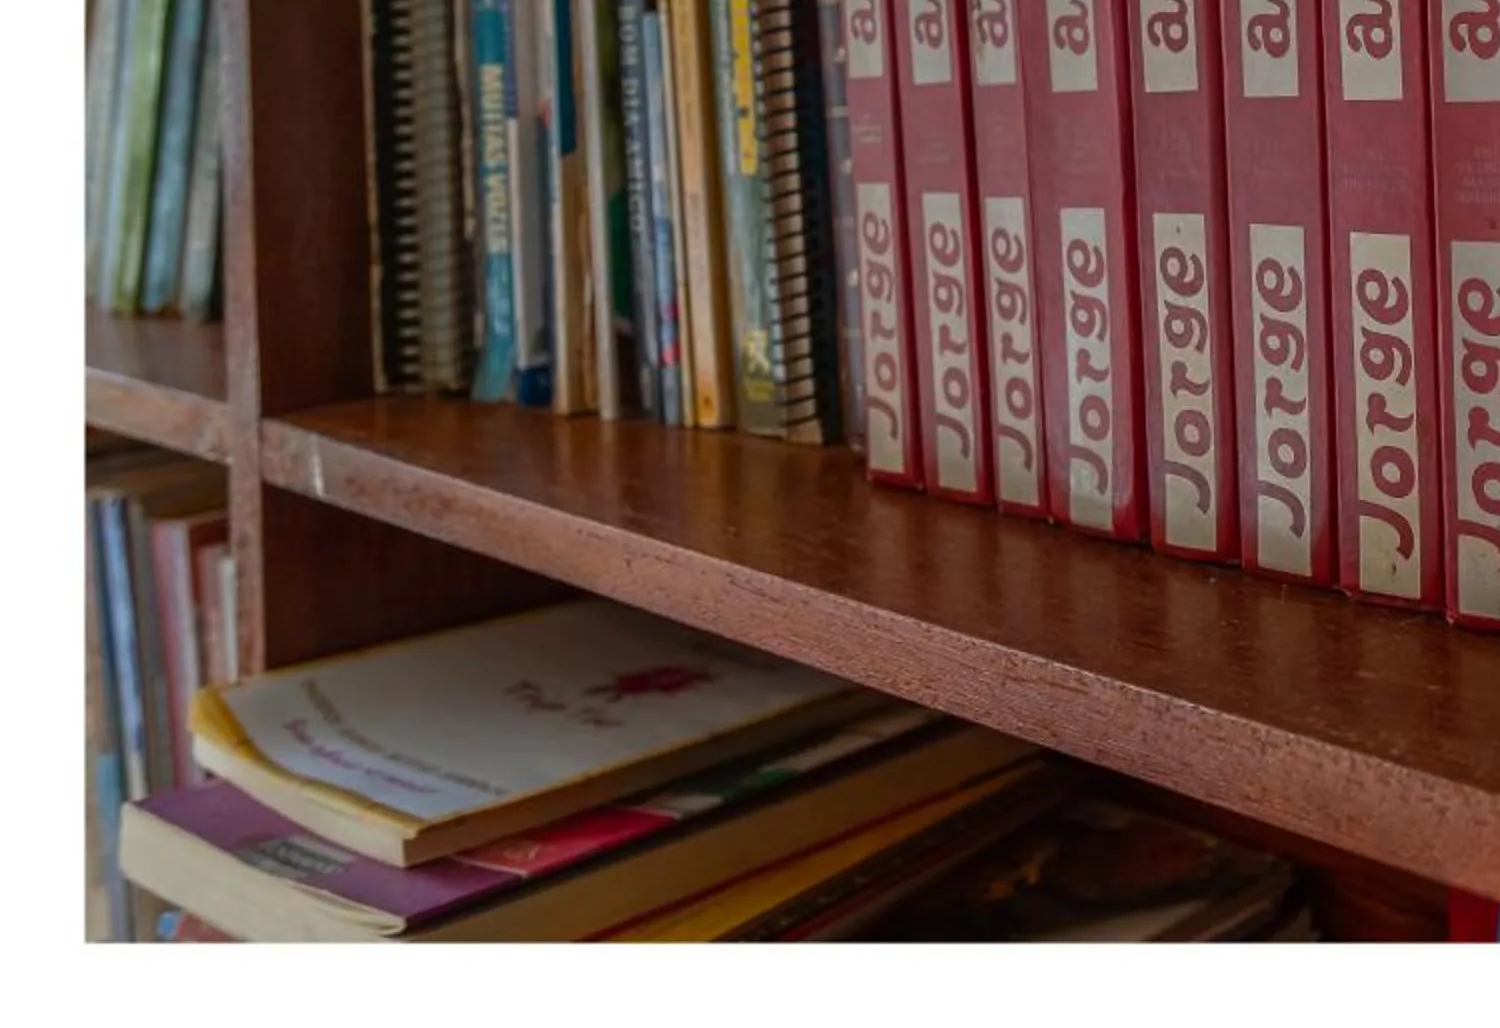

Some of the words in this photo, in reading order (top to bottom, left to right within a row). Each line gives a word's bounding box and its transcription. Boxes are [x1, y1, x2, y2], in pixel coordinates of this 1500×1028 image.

[863, 210, 896, 440] Jorge
[929, 221, 970, 459] Jorge
[991, 228, 1033, 471] Jorge
[1066, 238, 1111, 494] Jorge
[1160, 246, 1212, 514] Jorge
[1255, 257, 1308, 538] Jorge
[1356, 268, 1416, 561] Jorge
